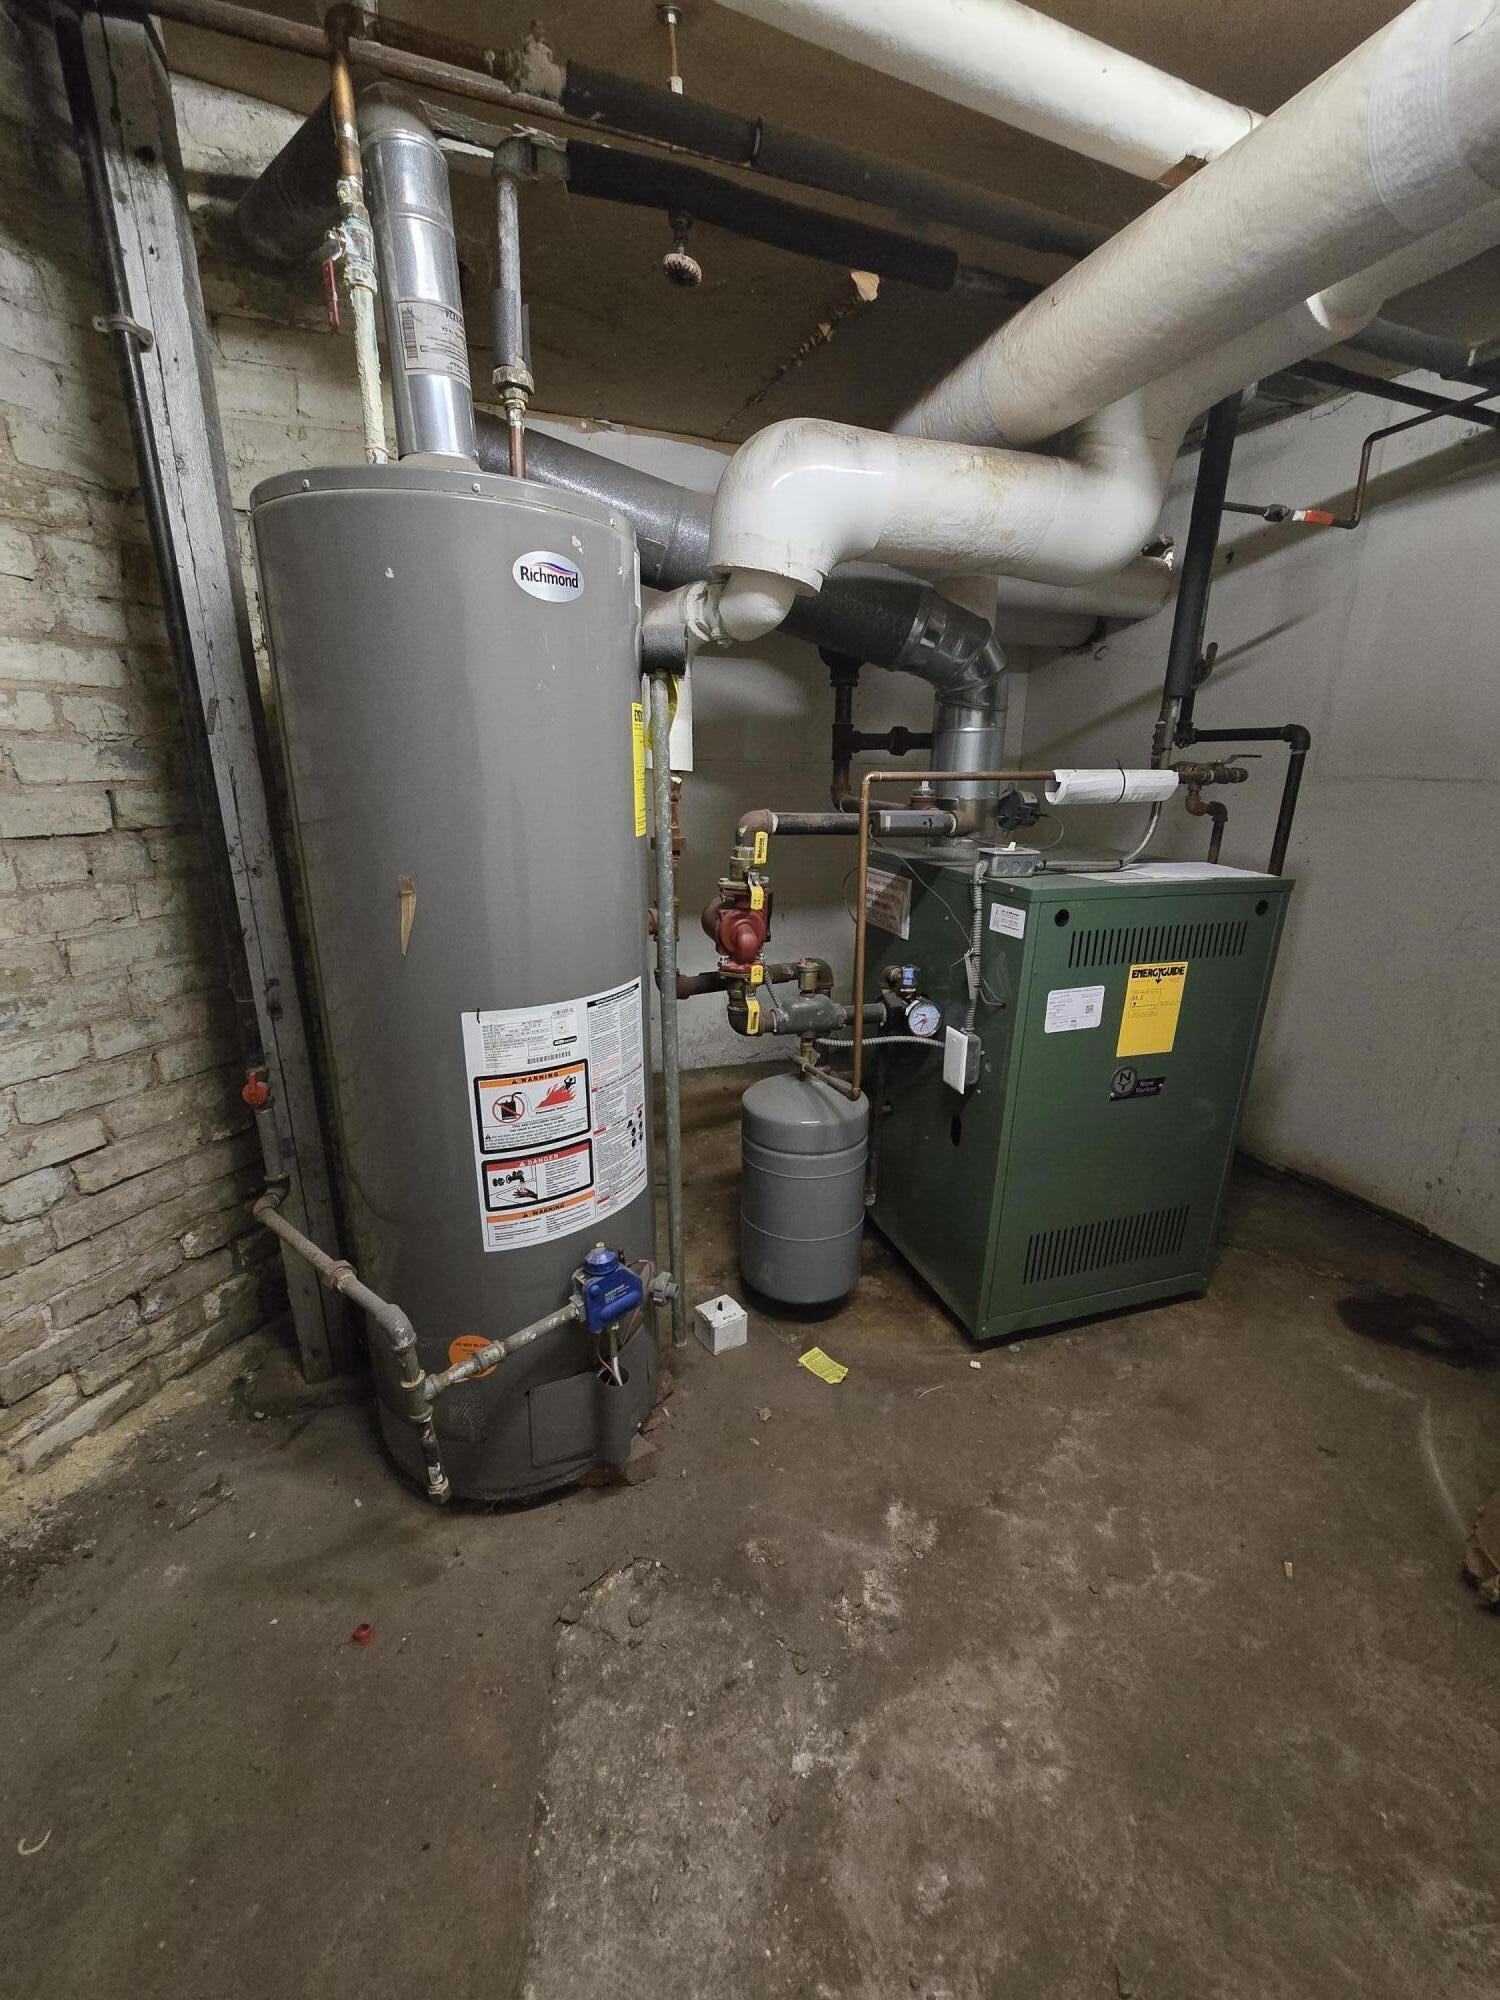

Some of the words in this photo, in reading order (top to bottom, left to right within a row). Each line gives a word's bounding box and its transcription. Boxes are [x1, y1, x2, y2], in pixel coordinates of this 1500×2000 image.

[520, 565, 579, 588] Richmond
[1131, 966, 1186, 979] ENERGYGUIDE
[521, 1071, 559, 1083] WARNING
[527, 1153, 559, 1165] DANGER
[532, 1203, 565, 1216] WARNING
